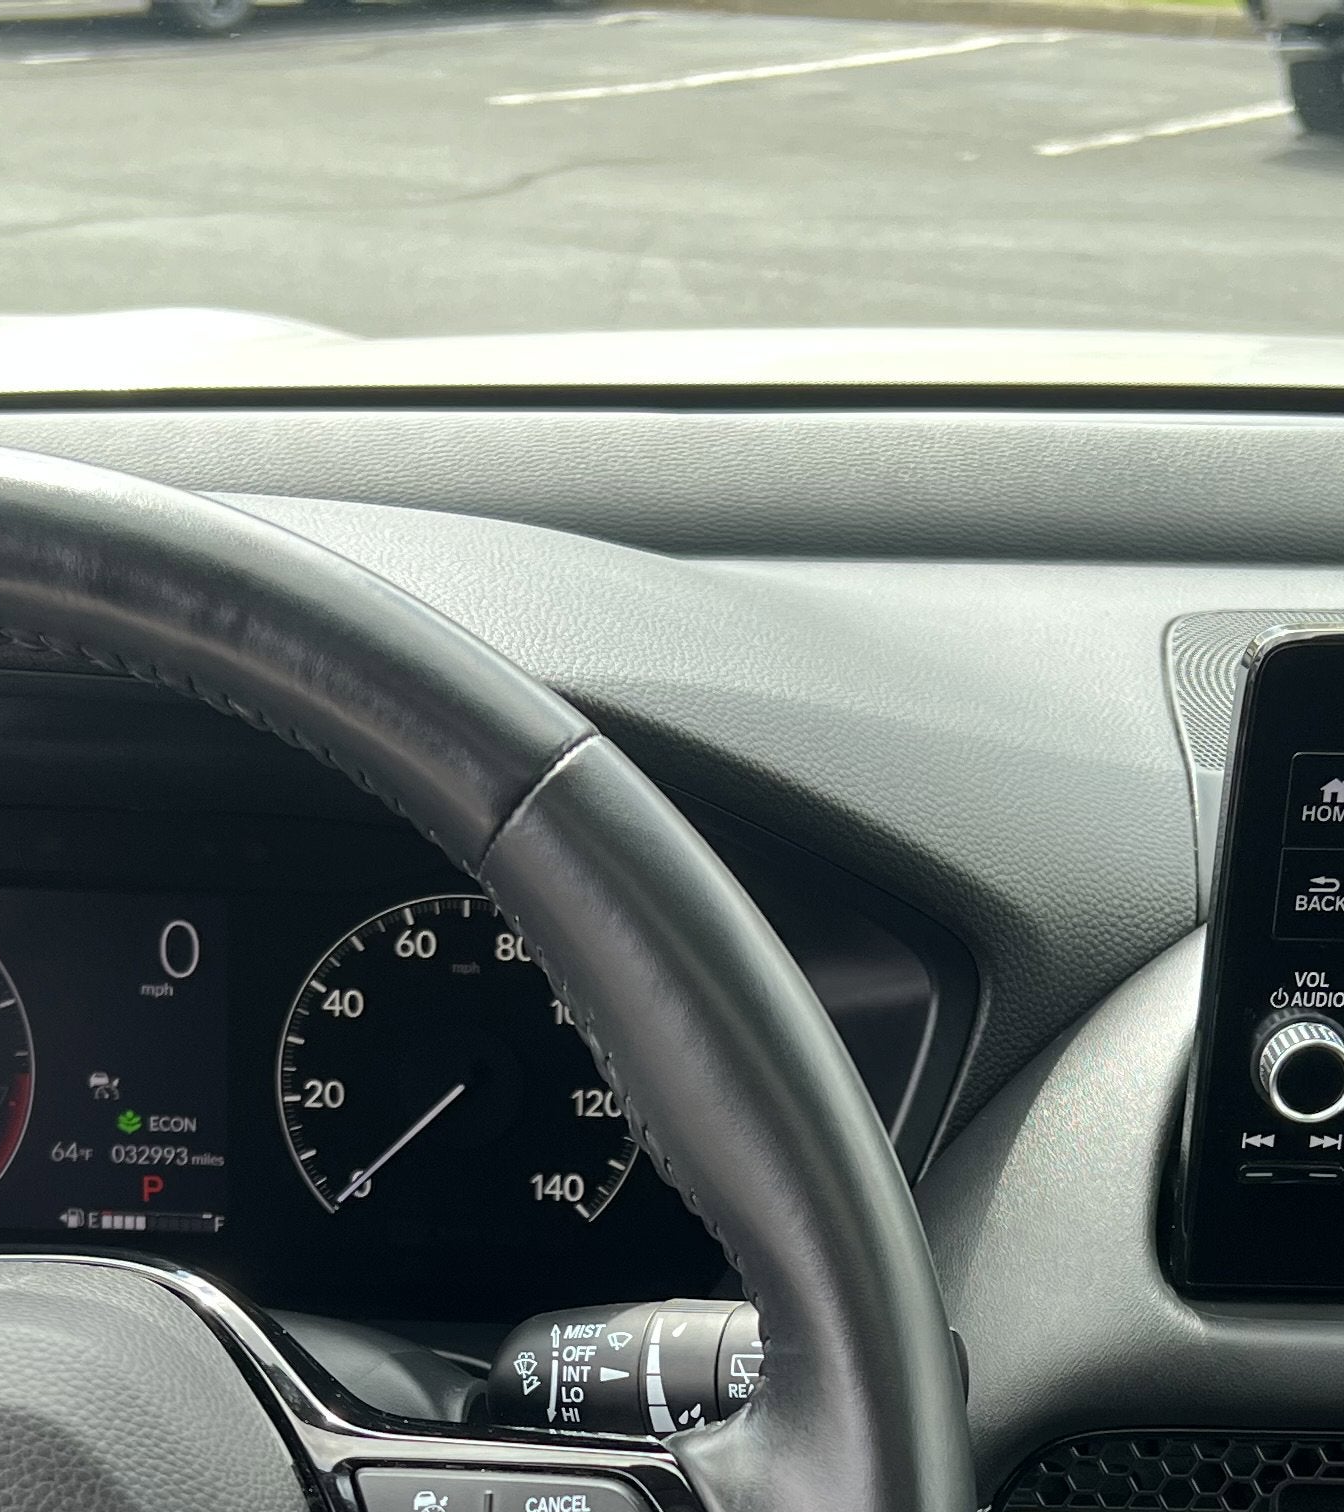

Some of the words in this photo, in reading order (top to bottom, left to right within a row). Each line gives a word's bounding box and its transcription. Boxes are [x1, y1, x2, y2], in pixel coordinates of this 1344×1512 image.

[159, 919, 200, 979] 0
[395, 930, 437, 958] 60
[1294, 971, 1330, 988] VOL
[141, 982, 174, 998] mph
[323, 990, 365, 1018] 40
[304, 1080, 345, 1109] 20
[149, 1116, 197, 1132] ECON
[112, 1145, 188, 1166] 032993
[192, 1154, 225, 1166] miles
[142, 1175, 165, 1202] P
[530, 1175, 584, 1201] 140
[88, 1212, 98, 1229] E
[214, 1216, 225, 1232] F
[563, 1324, 606, 1340] MIST
[562, 1346, 596, 1362] OFF
[562, 1366, 591, 1382] INT
[561, 1387, 584, 1403] LO
[561, 1407, 580, 1422] HI
